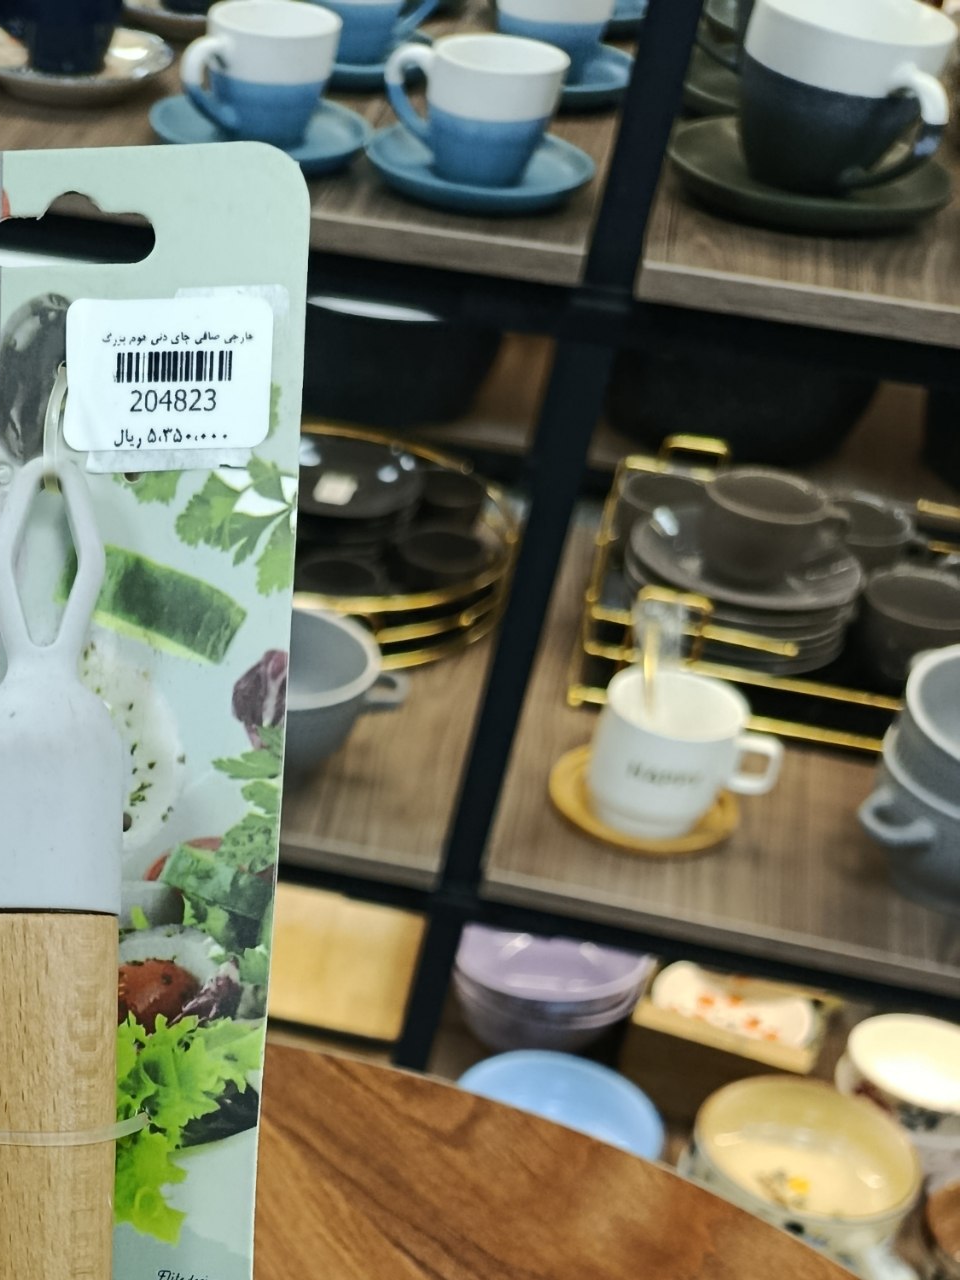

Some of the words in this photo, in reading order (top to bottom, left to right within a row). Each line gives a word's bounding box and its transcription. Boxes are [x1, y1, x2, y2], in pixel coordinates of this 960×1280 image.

[150, 332, 168, 346] دنی
[194, 331, 220, 345] صافی
[129, 388, 217, 412] 204823
[113, 427, 143, 449] ریال
